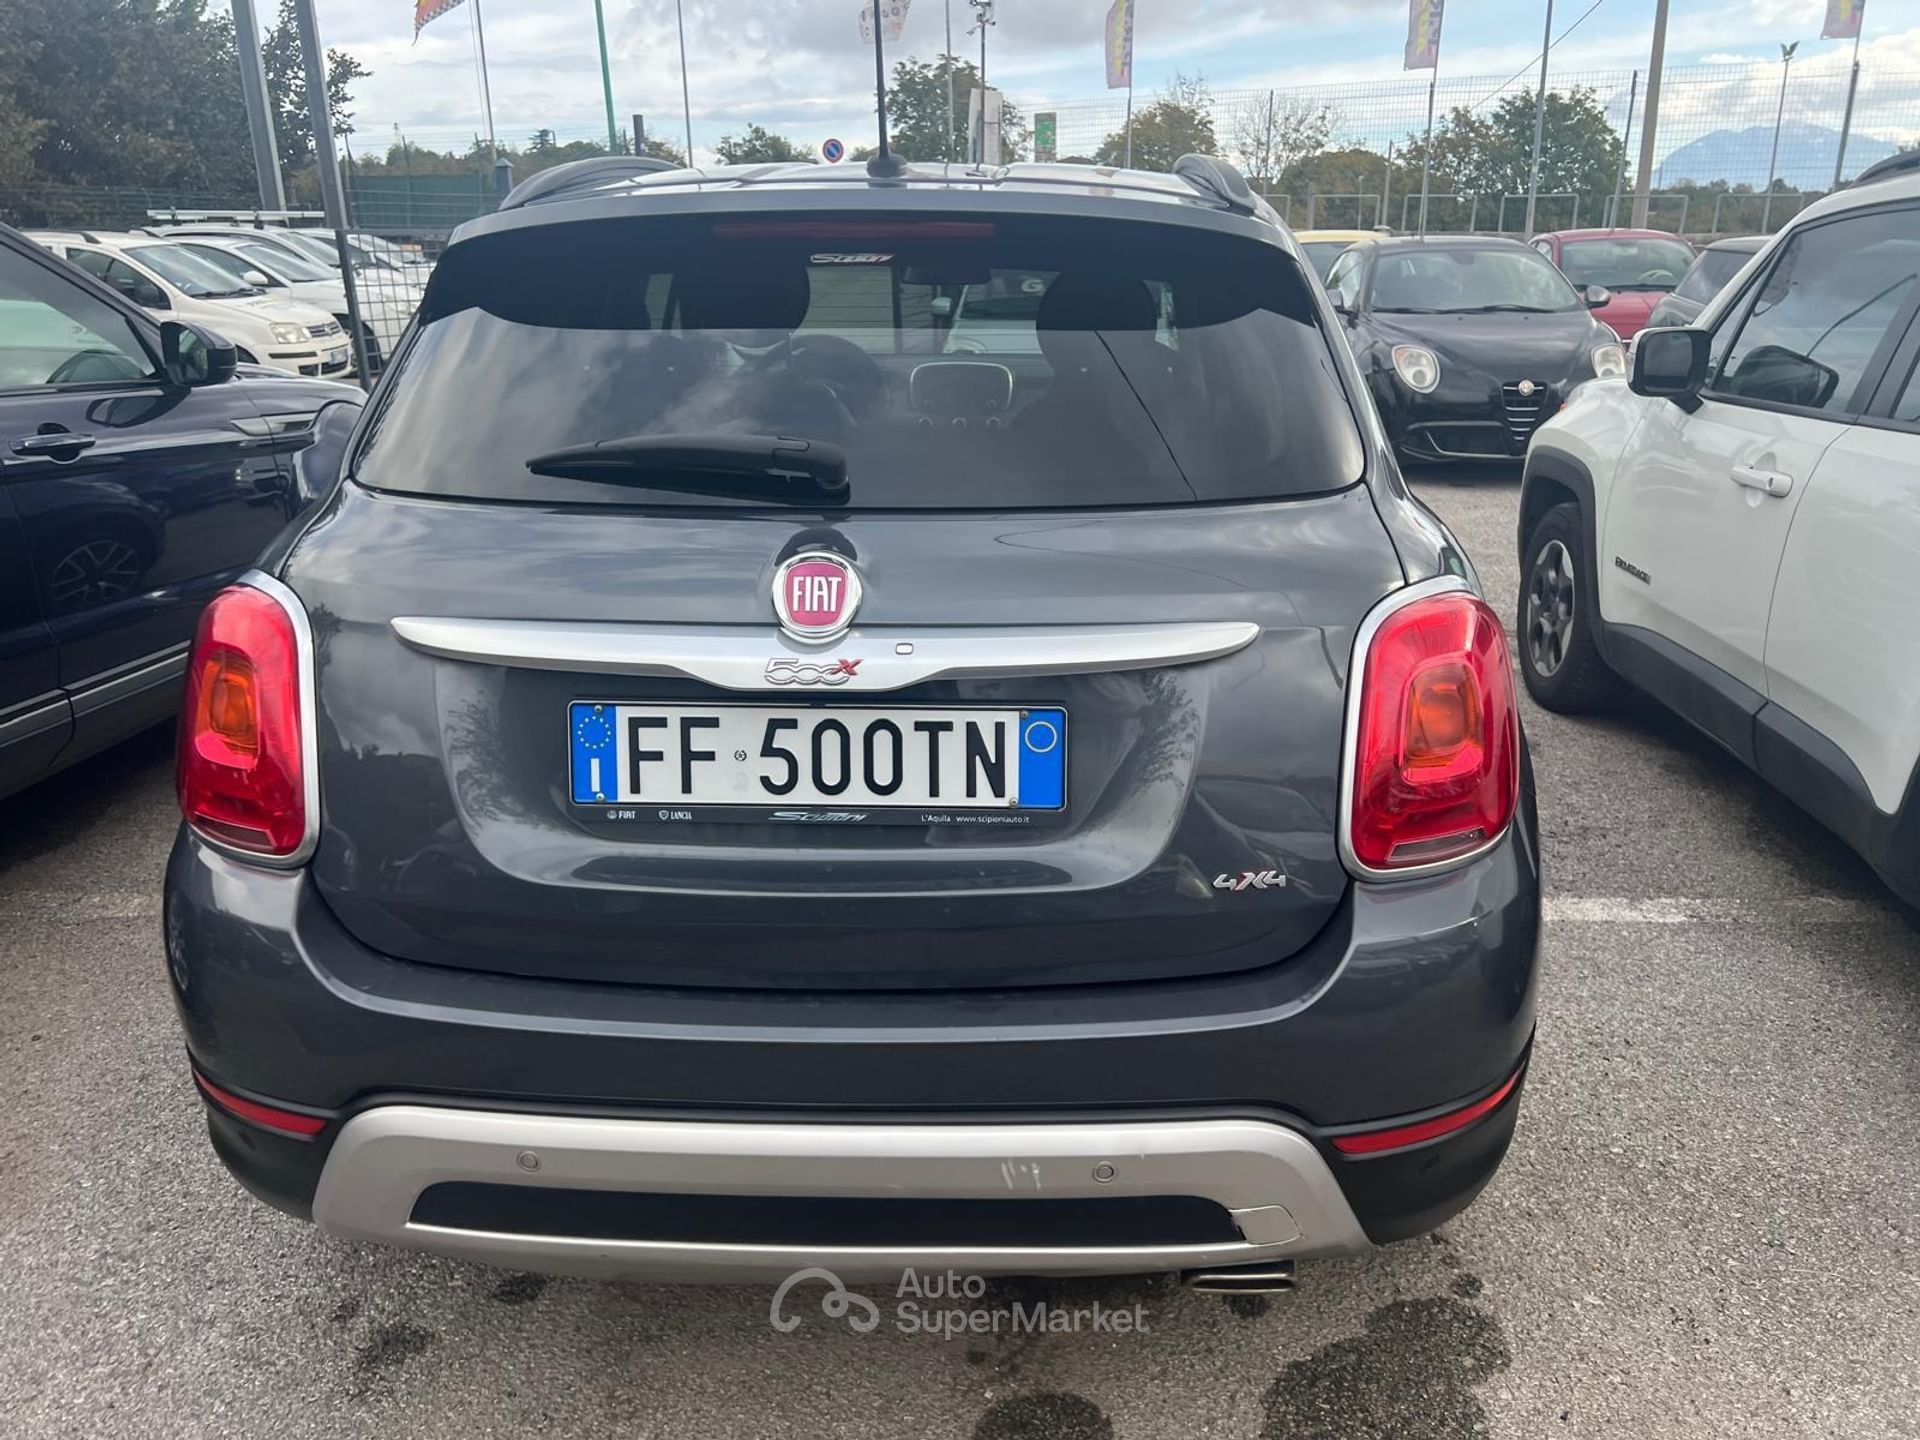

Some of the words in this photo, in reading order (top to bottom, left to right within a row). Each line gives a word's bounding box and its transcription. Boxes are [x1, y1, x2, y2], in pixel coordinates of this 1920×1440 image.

[792, 576, 842, 612] FIAT
[627, 716, 720, 794] FF
[759, 718, 1006, 796] 500TN
[618, 810, 636, 819] FIAT
[670, 811, 693, 820] LANCIA
[921, 814, 951, 823] L'Aquila
